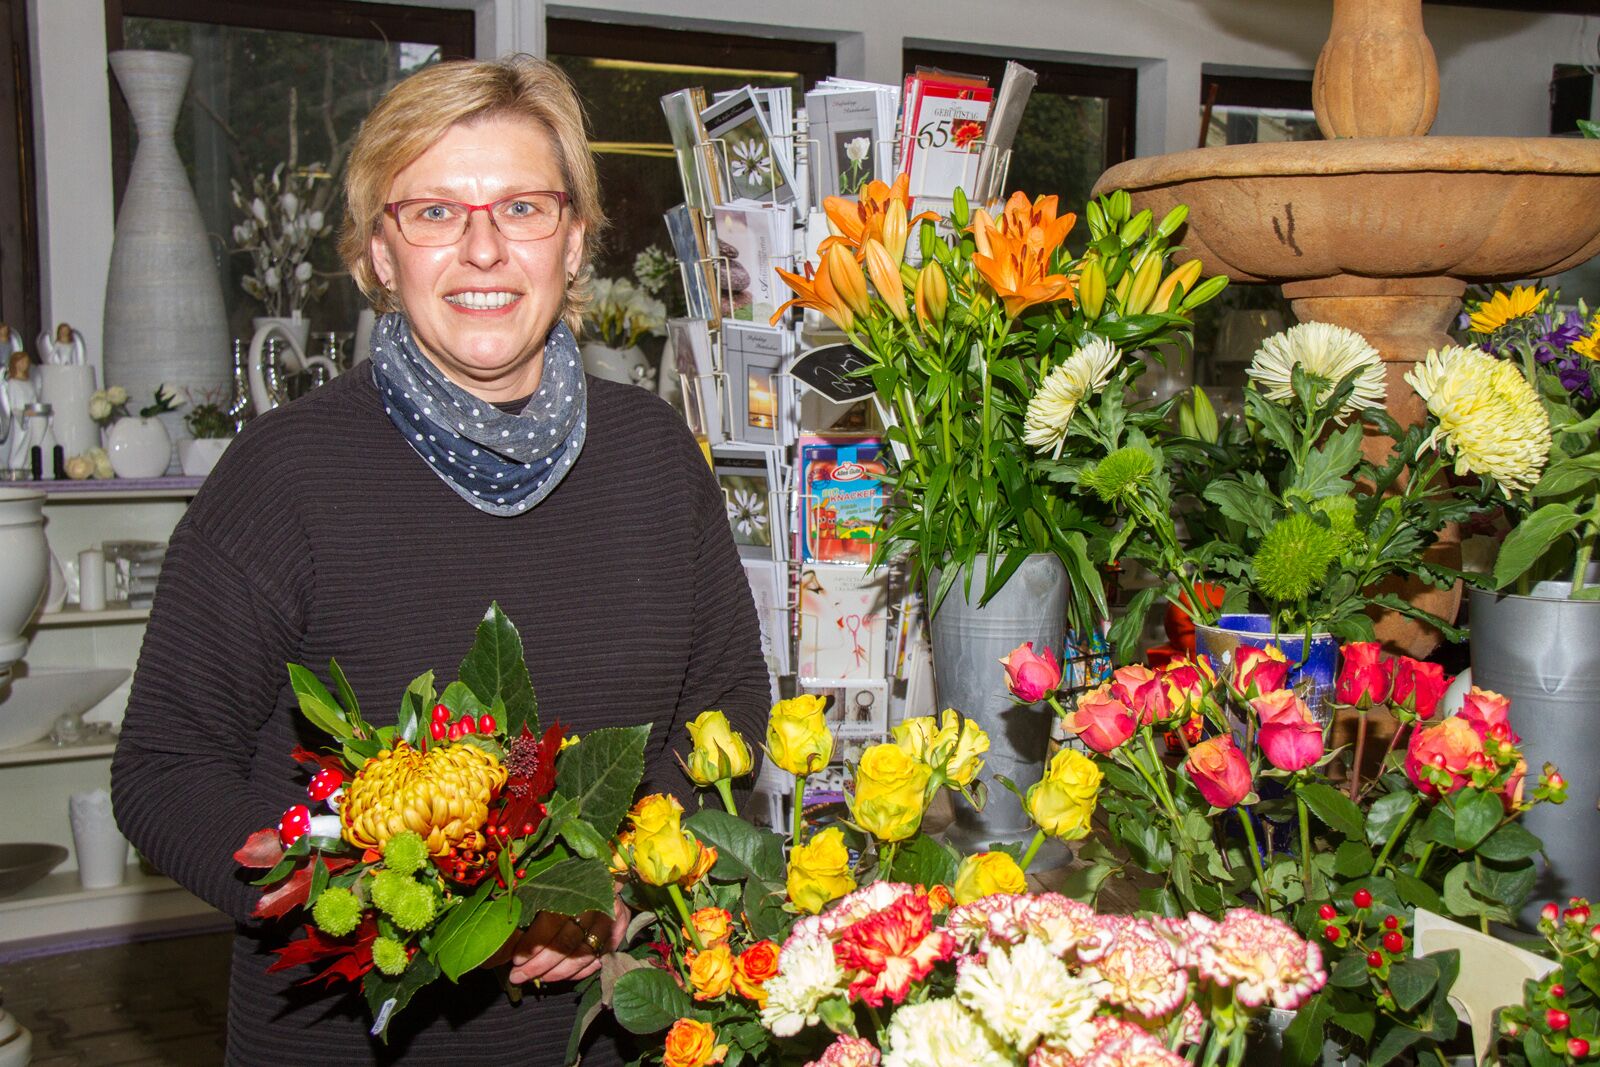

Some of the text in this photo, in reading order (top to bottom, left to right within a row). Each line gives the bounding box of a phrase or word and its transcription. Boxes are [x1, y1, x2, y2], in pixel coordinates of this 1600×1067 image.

[934, 107, 979, 120] GEBURTSTAG
[917, 120, 951, 150] 65
[829, 488, 877, 503] KNACKER
